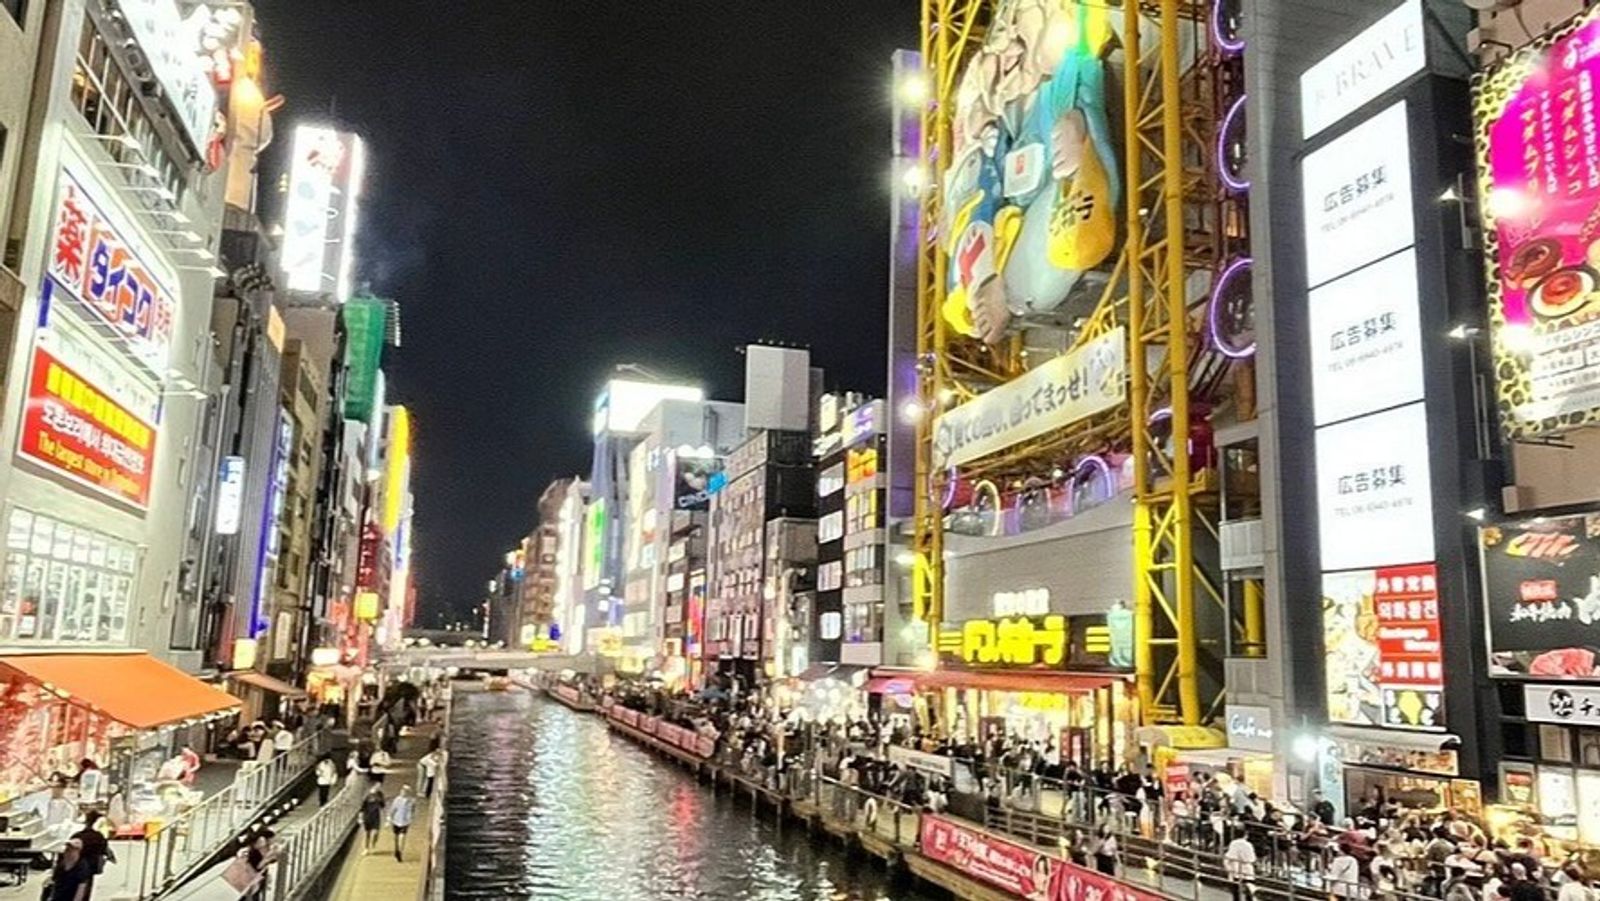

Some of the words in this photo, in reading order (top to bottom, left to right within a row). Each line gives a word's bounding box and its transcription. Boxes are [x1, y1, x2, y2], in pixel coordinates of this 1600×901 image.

[1323, 165, 1388, 213] 広告募集
[1330, 312, 1398, 351] 広告募集
[1337, 464, 1406, 495] 広告募集
